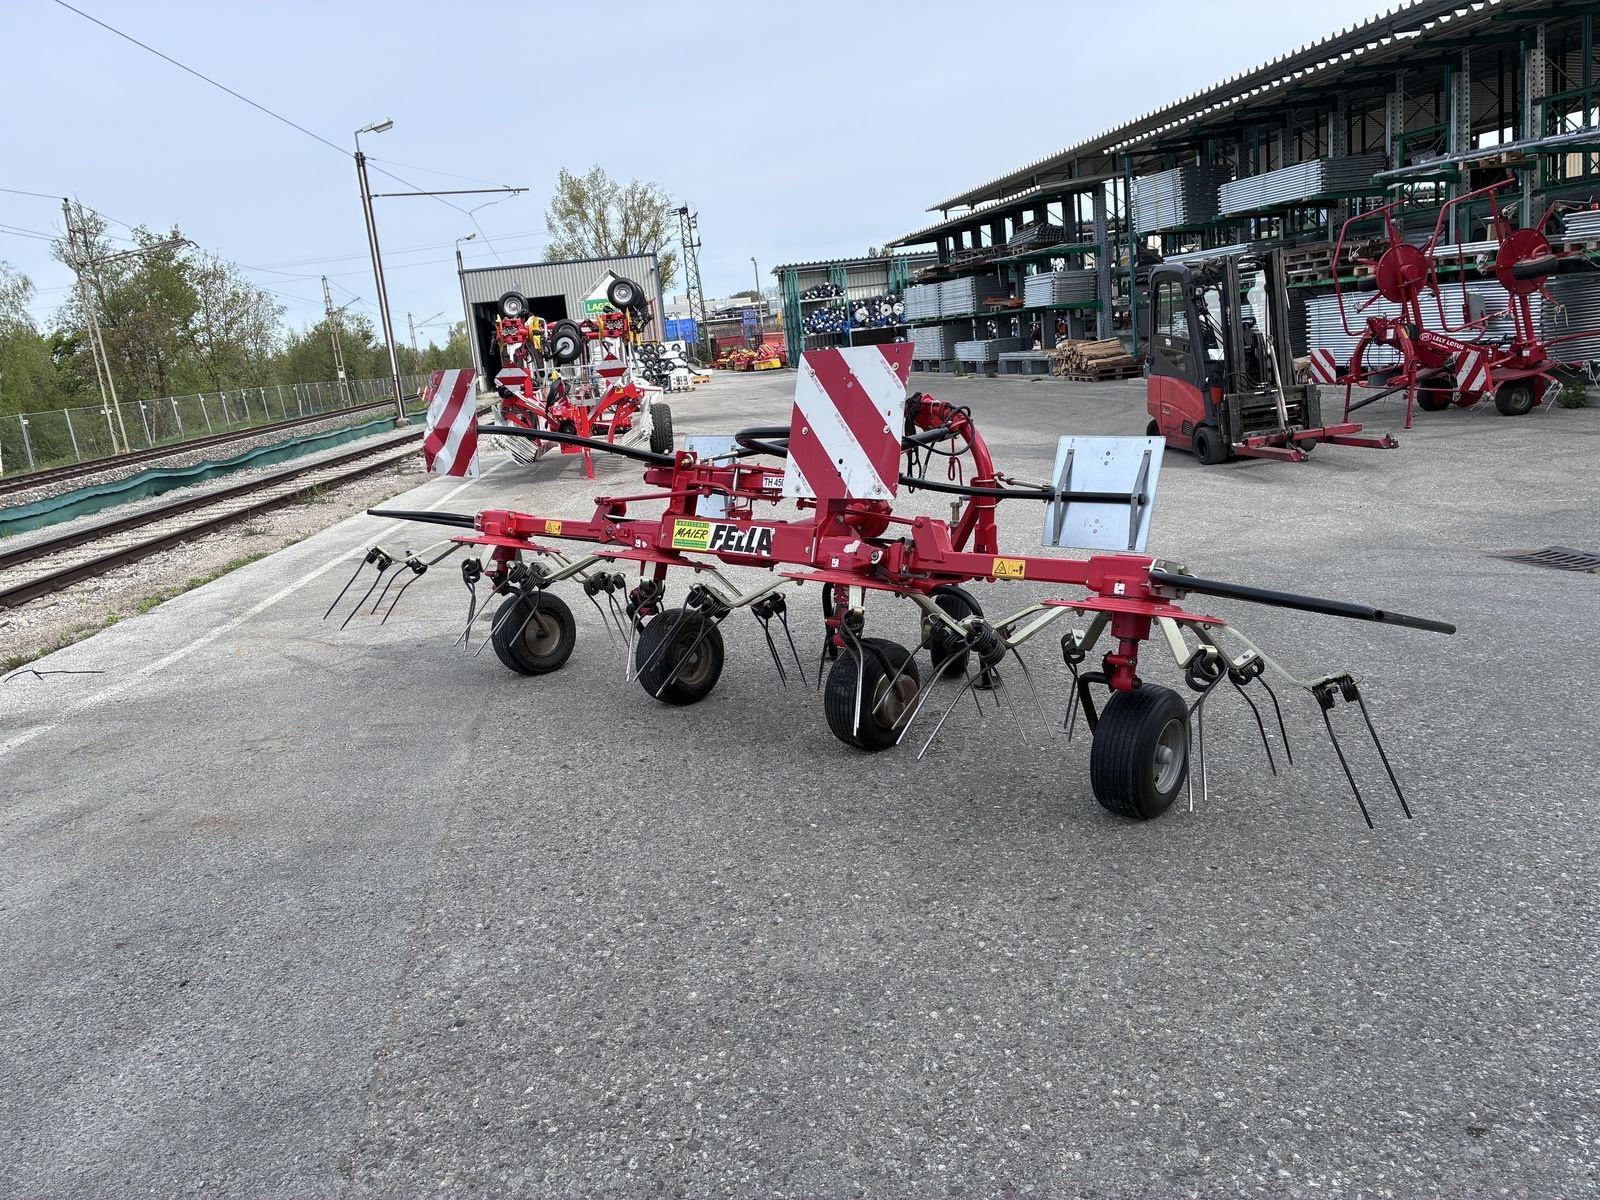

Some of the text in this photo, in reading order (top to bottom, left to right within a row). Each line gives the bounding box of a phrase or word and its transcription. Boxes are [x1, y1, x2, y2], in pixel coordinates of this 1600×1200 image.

[587, 302, 613, 311] LAG
[1432, 335, 1447, 343] LELY
[1446, 339, 1464, 350] LOTUS
[764, 477, 773, 487] TH
[674, 527, 709, 540] MAIER
[709, 524, 772, 555] FELLA
